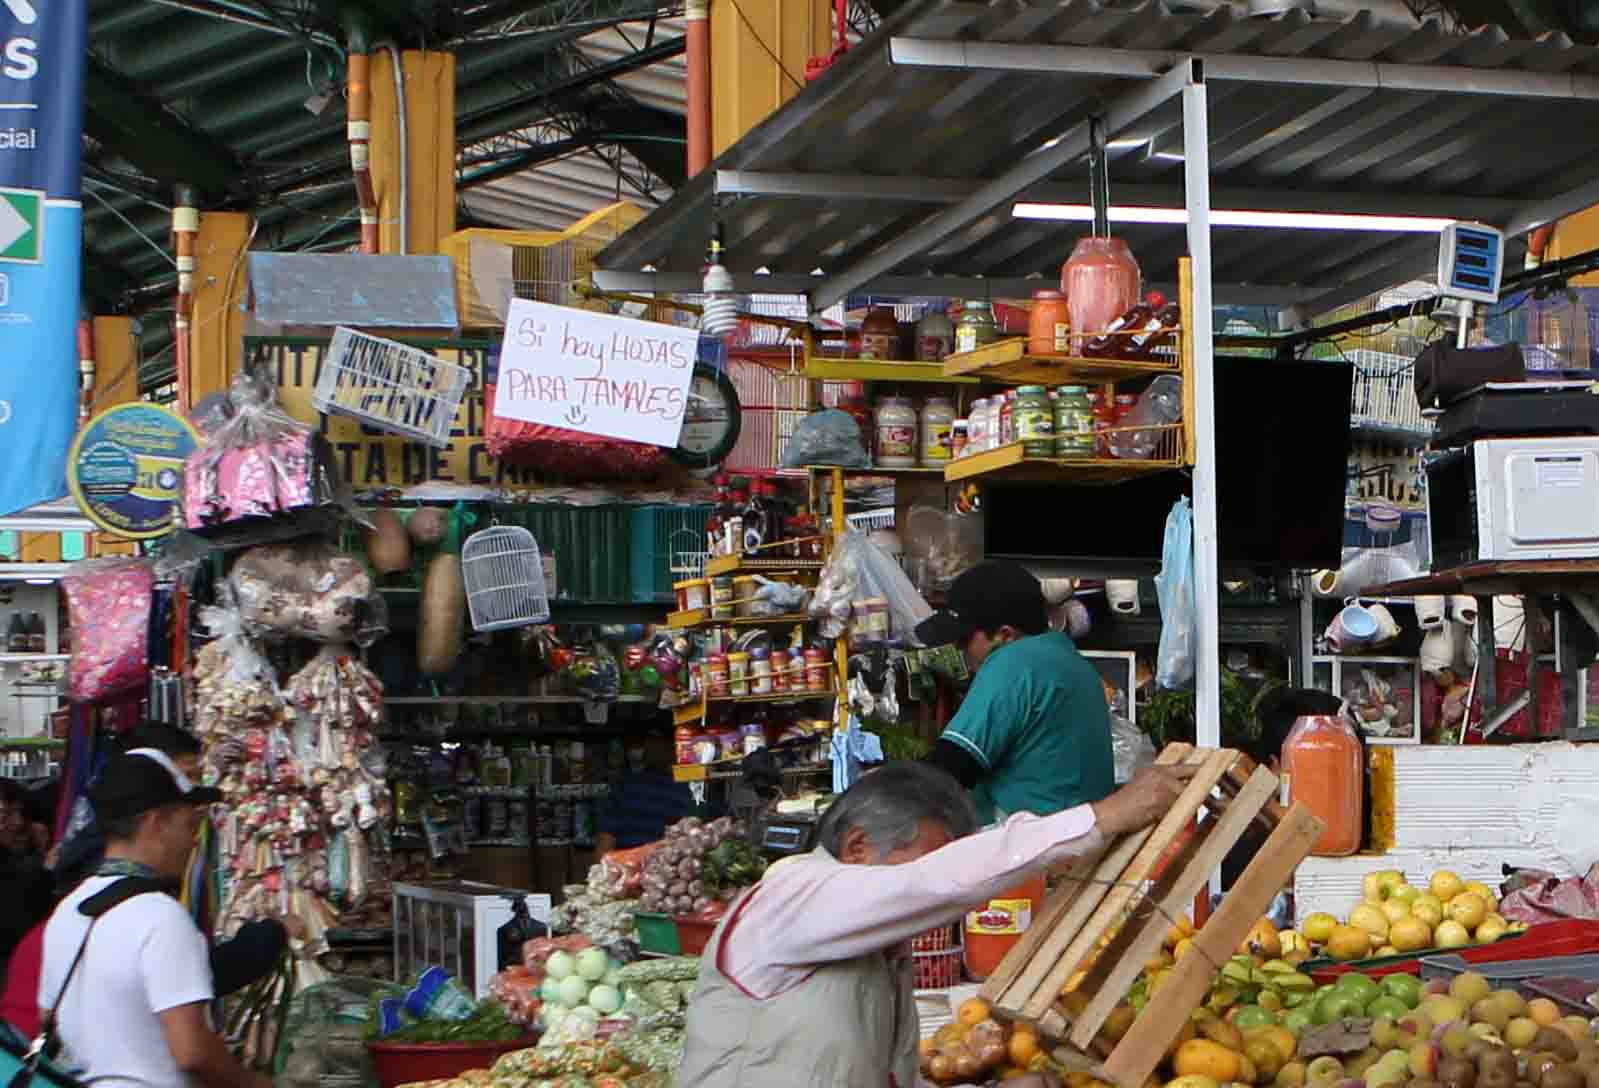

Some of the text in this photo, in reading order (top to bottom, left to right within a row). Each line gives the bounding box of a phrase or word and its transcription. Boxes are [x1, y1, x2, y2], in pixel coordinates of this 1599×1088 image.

[560, 320, 604, 380] hay
[610, 330, 688, 369] HOJAS
[505, 367, 685, 421] PARA TAMALES
